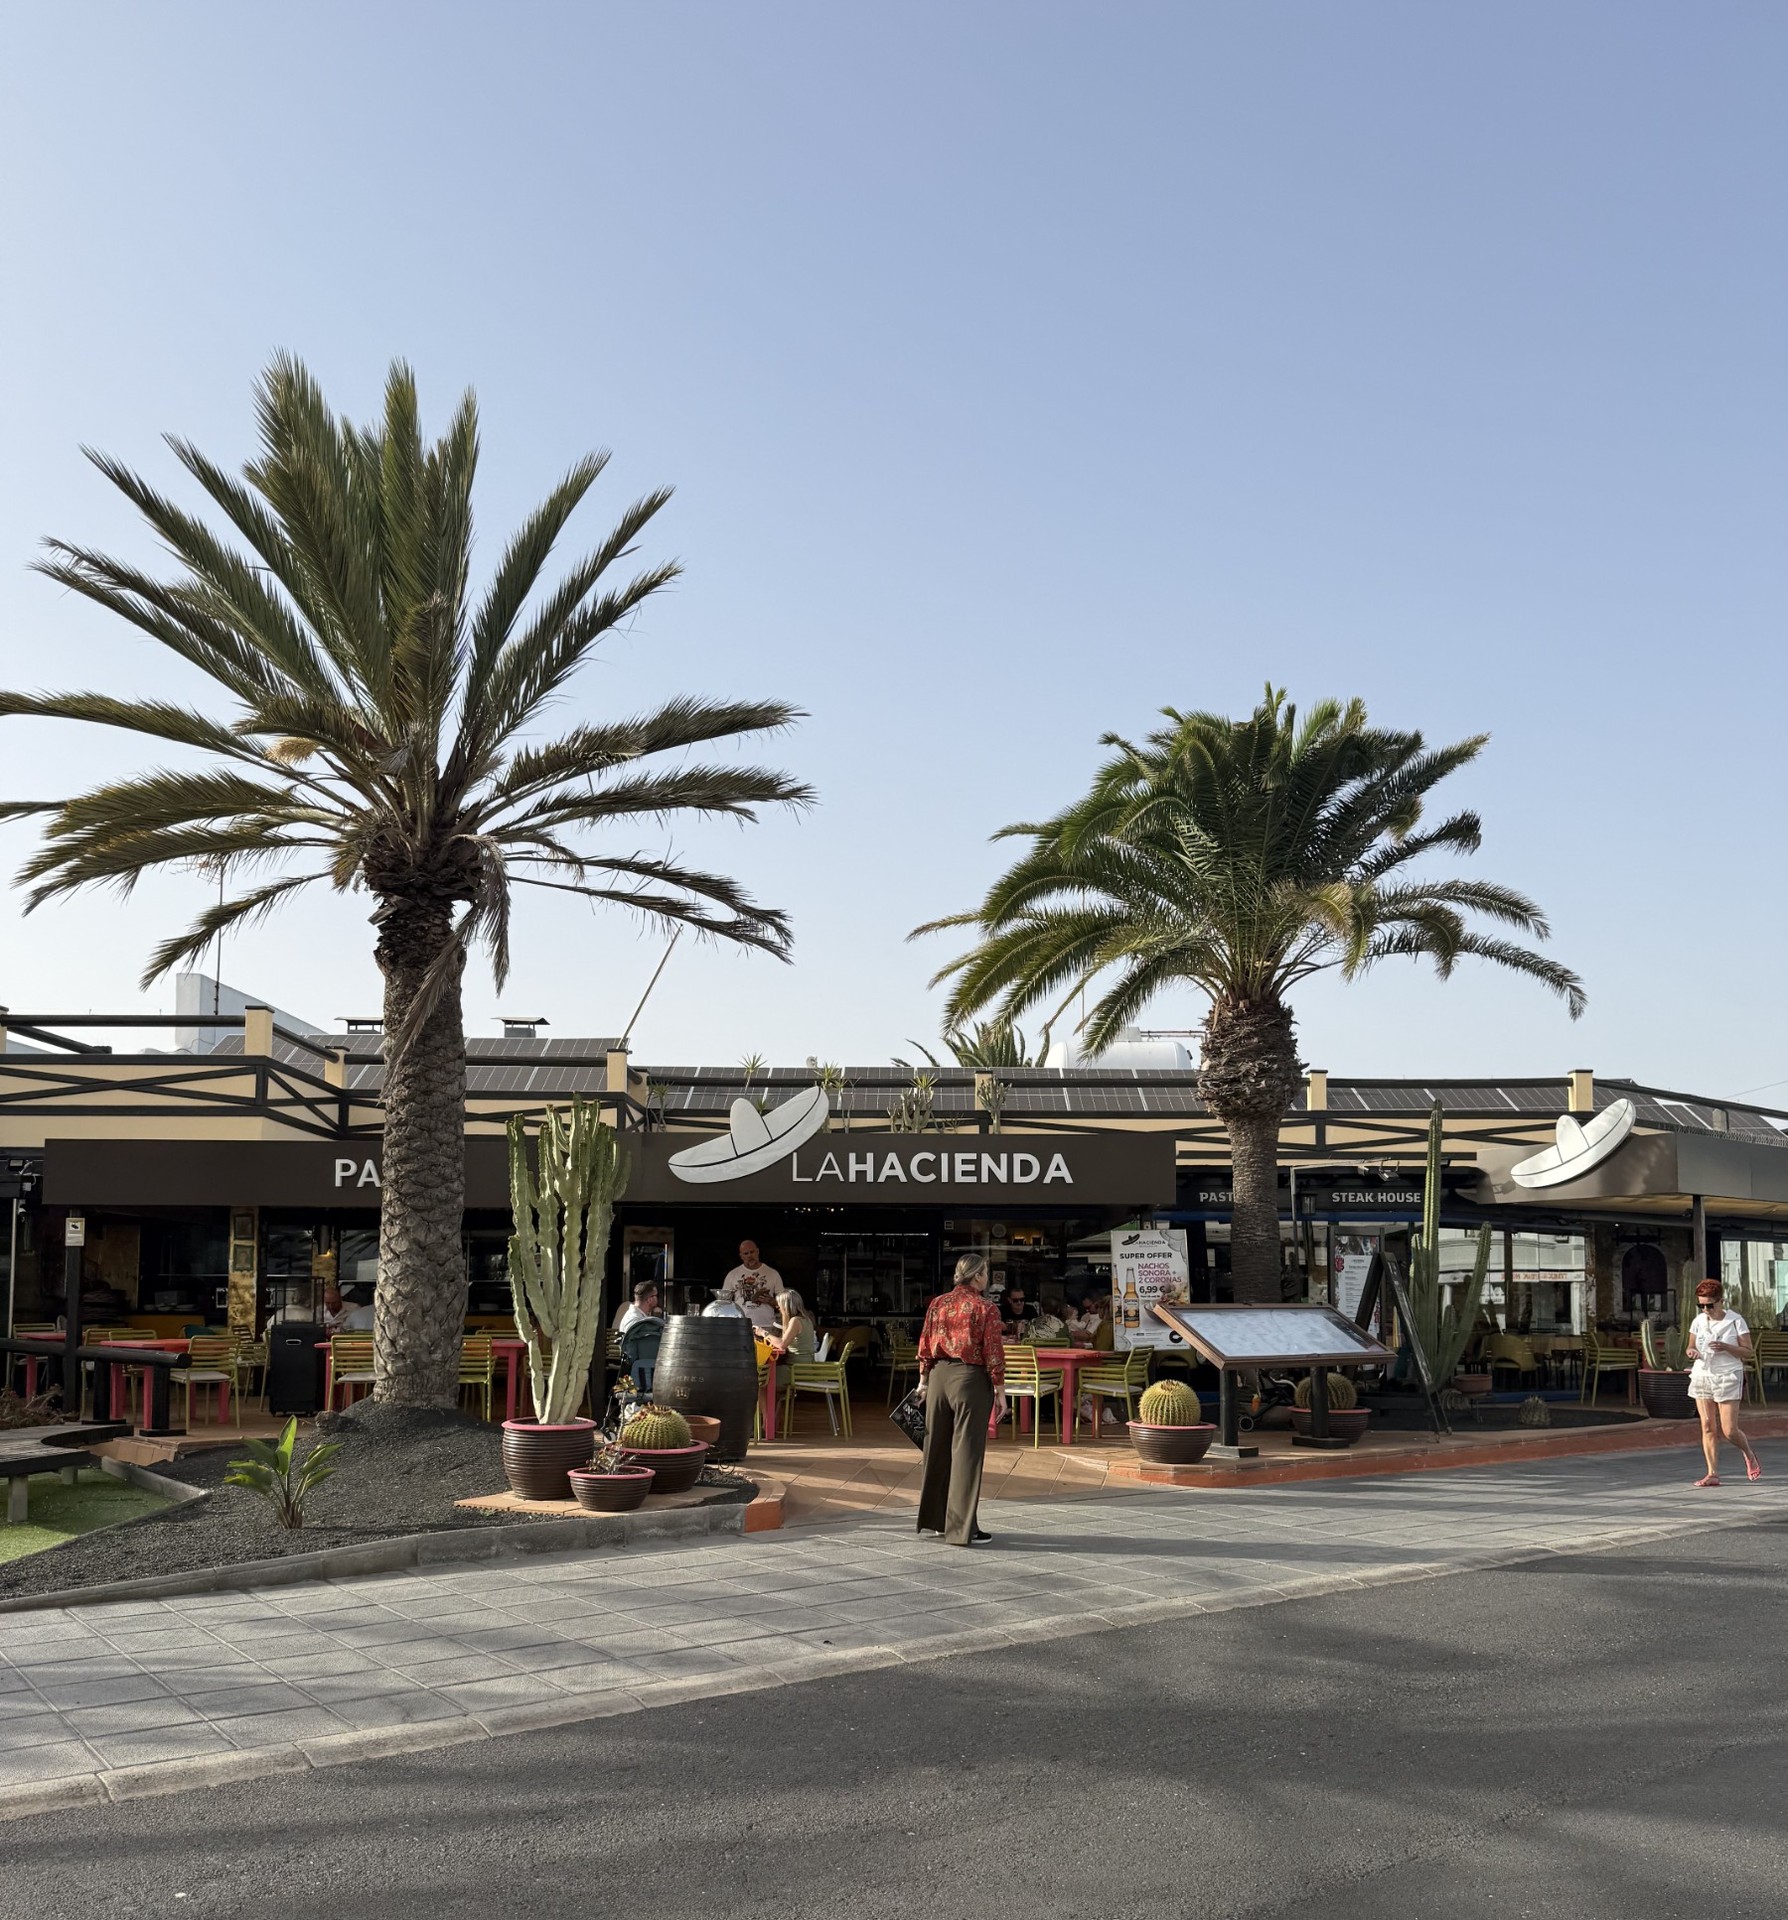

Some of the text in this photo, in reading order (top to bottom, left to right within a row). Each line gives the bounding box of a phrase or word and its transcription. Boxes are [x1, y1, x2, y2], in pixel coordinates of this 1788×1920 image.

[792, 1152, 1074, 1184] LAHACIENDA
[1331, 1192, 1421, 1203] STEAK HOUSE
[1144, 1276, 1182, 1284] CORONAS
[1139, 1285, 1158, 1294] 6,99
